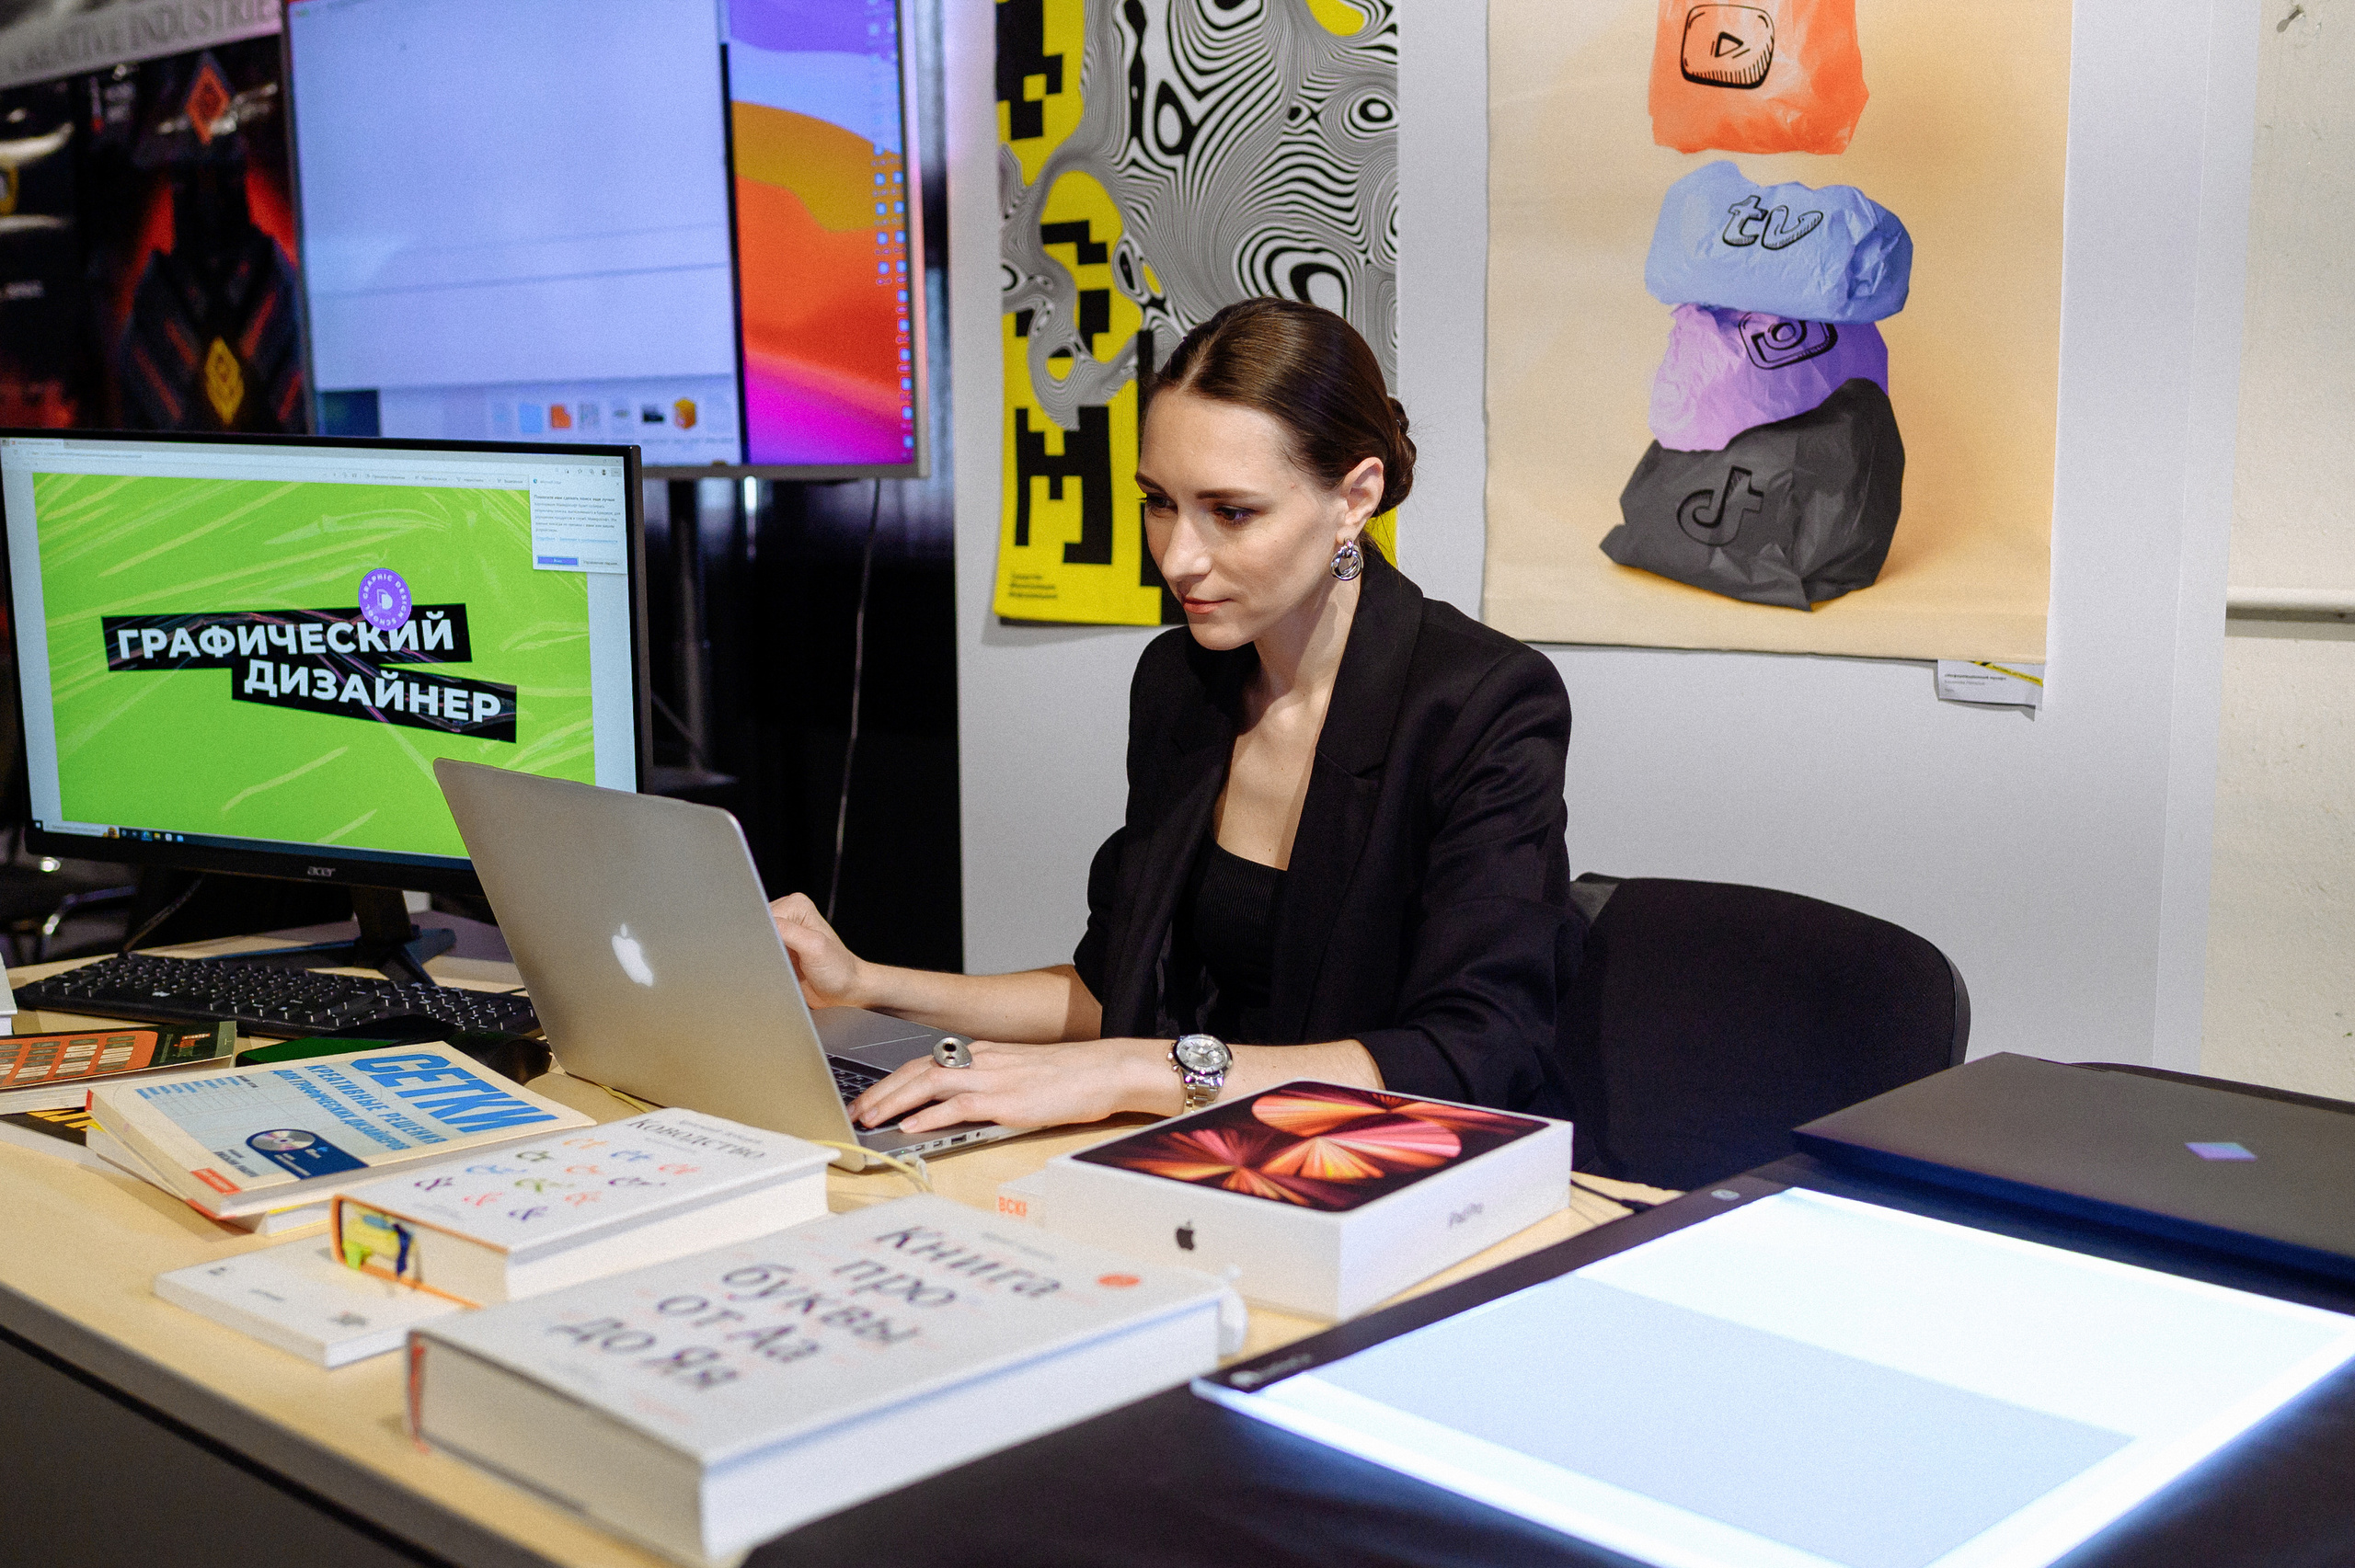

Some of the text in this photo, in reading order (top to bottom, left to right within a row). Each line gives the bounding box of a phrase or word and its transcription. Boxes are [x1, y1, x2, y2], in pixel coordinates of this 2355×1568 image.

[117, 612, 454, 659] ГРАФИЧЕСКИЙ
[244, 659, 501, 724] ДИЗАЙНЕР
[307, 865, 336, 876] acer
[304, 1065, 449, 1144] КРЕАТИВНЫЕ РЕШЕНИЯ
[350, 1053, 558, 1133] СЕТКИ
[833, 1259, 956, 1309] про
[875, 1226, 1061, 1298] Книга
[658, 1294, 744, 1327] от
[722, 1264, 918, 1345] буквы
[549, 1317, 656, 1355] до
